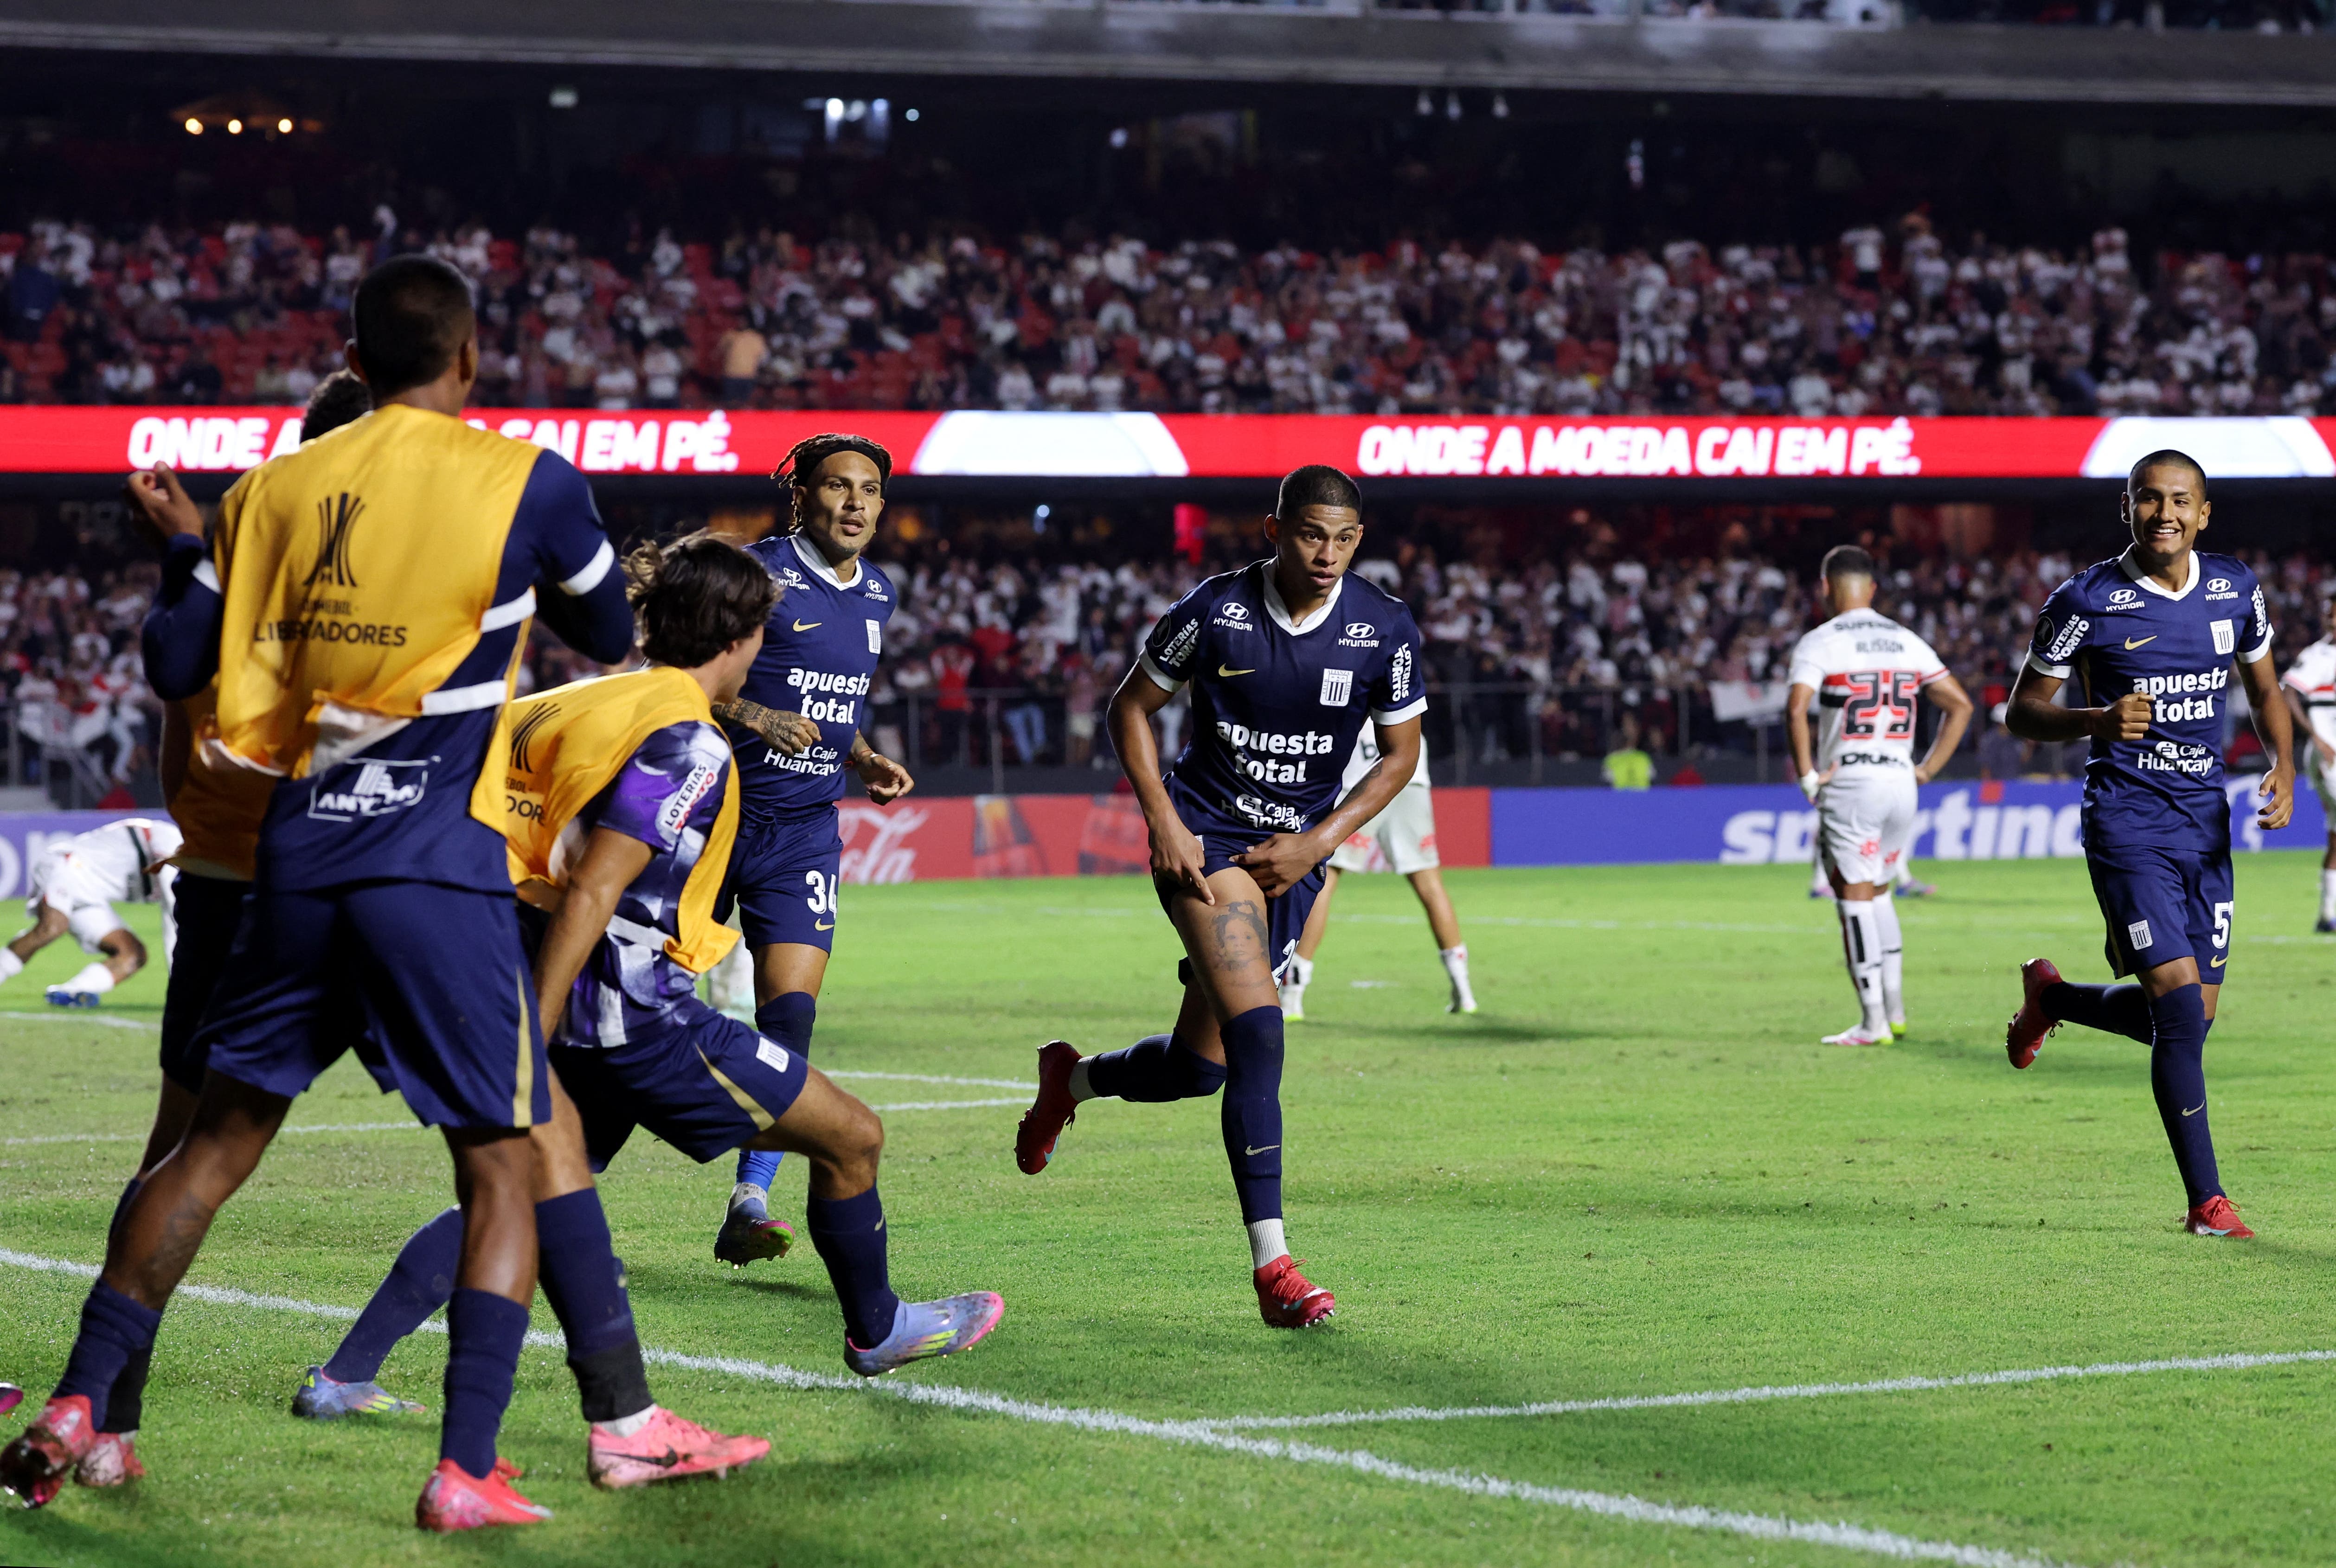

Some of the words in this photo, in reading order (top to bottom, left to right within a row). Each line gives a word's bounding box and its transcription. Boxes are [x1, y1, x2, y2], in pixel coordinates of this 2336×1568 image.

[128, 417, 270, 469] ONDE
[581, 420, 661, 472] EM
[662, 410, 739, 472] PÉ.
[1358, 426, 1489, 475] ONDE
[1486, 426, 1526, 475] A
[1528, 426, 1692, 475] MOEDA
[1696, 427, 1775, 475] CAI
[1775, 428, 1848, 475] EM
[1848, 417, 1922, 475] PÉ.
[864, 592, 888, 602] HYUNDAI
[2105, 601, 2145, 612] HYUNDAI
[2205, 591, 2239, 601] HYUNDAI
[1213, 618, 1253, 632] HYUNDAI
[1338, 638, 1380, 648] HYUNDAI
[2053, 620, 2090, 662] TORITO
[787, 668, 870, 696] apuesta
[1392, 647, 1404, 702] TORITO
[2133, 667, 2228, 700] apuesta
[800, 695, 855, 724] total
[1841, 671, 1917, 741] 25
[2155, 695, 2215, 723] total
[1216, 721, 1334, 755] apuesta
[2180, 744, 2206, 759] Caja
[812, 746, 838, 762] Caja
[1235, 752, 1306, 784] total
[1265, 803, 1295, 821] Caja
[806, 870, 837, 920] 34
